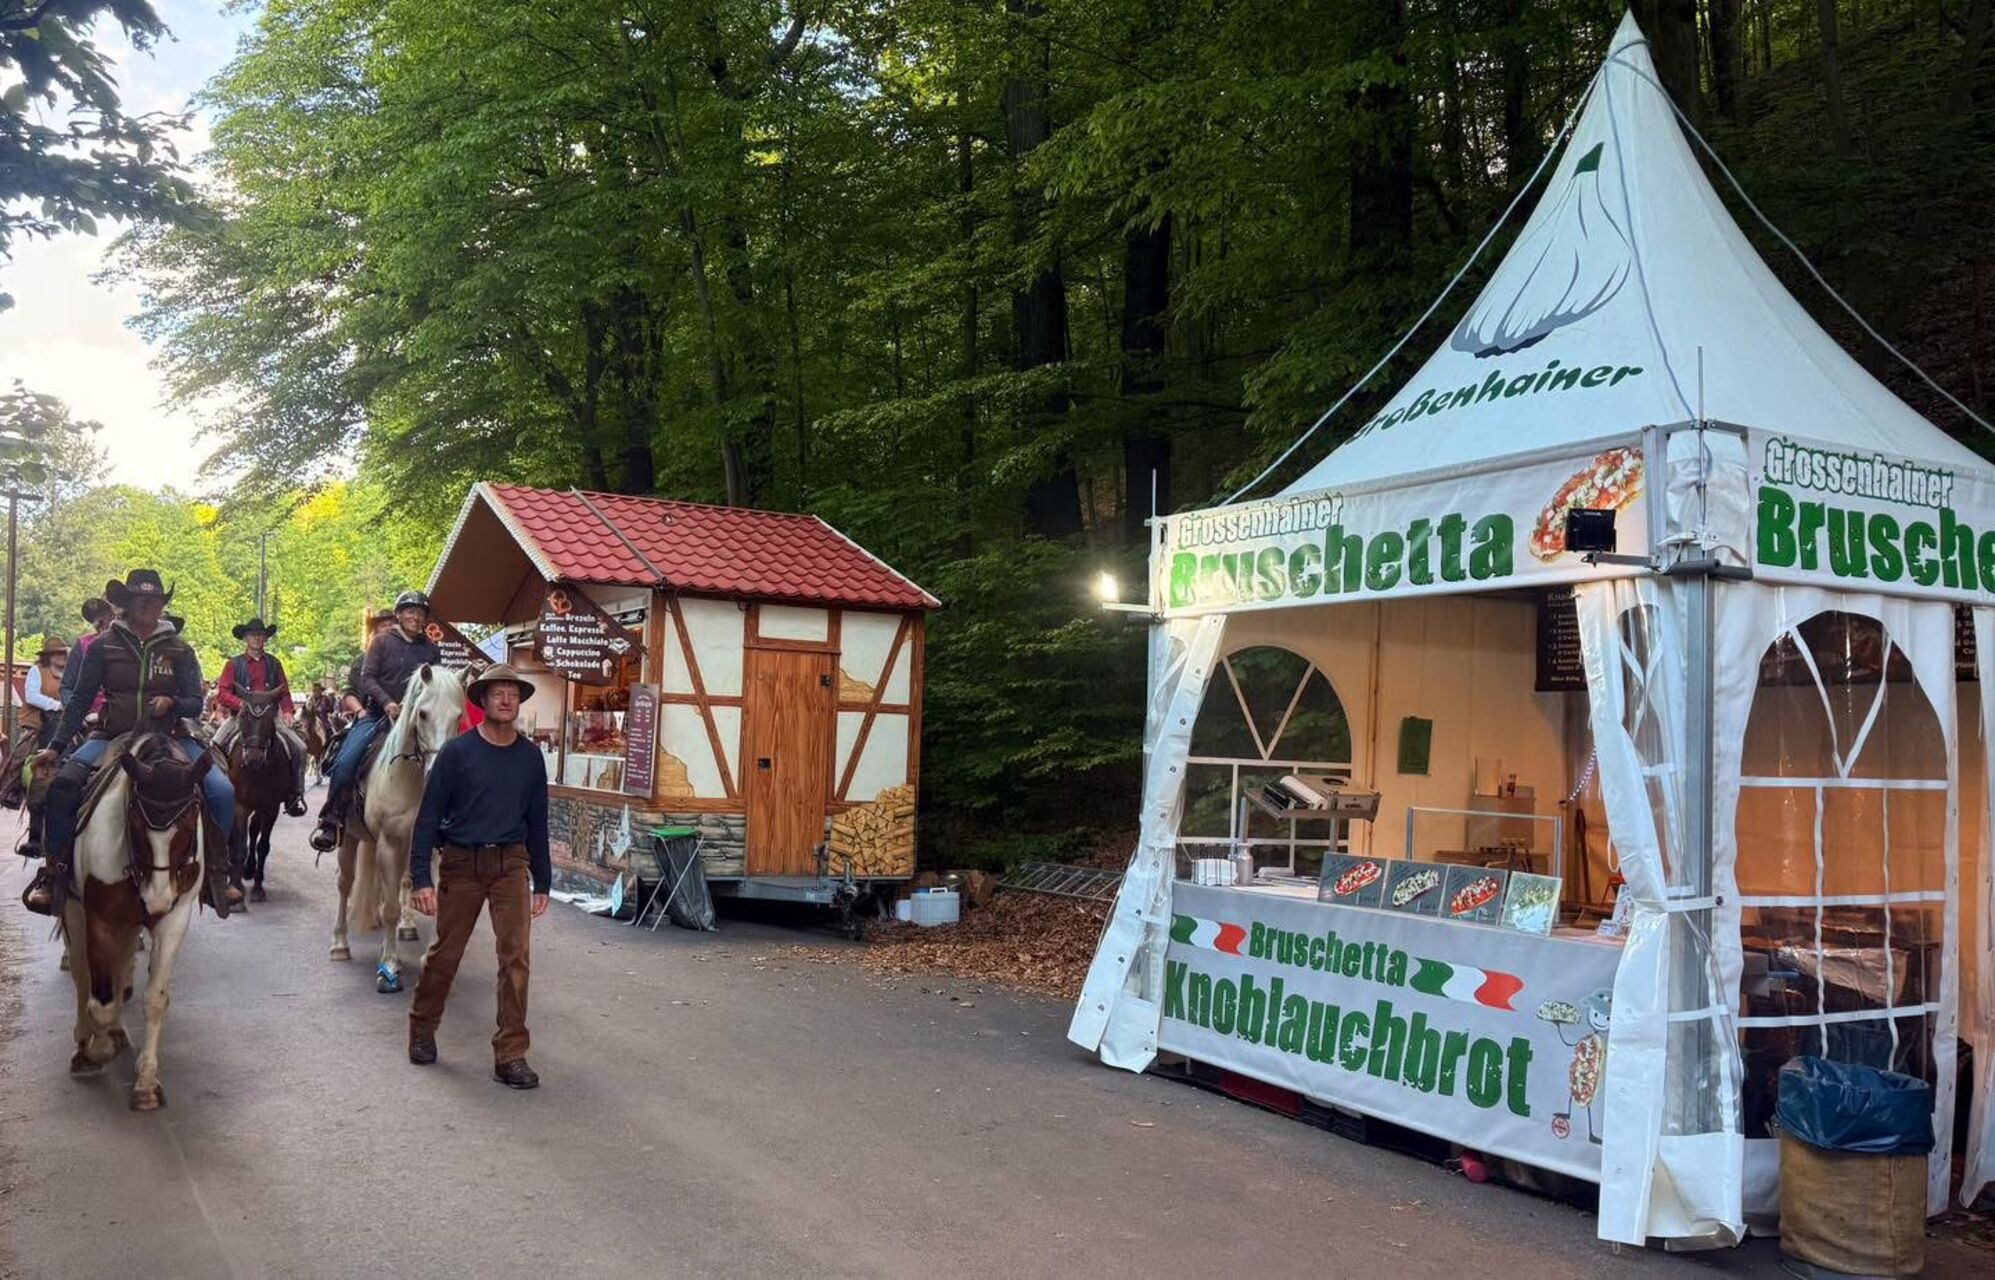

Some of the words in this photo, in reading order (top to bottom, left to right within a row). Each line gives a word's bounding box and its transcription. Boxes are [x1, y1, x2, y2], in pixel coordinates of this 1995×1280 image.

[1763, 435, 1954, 508] Grossenhainer
[1178, 492, 1344, 549] Grossenhainer
[1170, 512, 1514, 609] Bruschetta
[546, 635, 568, 644] Latte
[569, 636, 609, 646] Macchiato
[555, 659, 601, 669] Schokolade
[556, 646, 601, 657] Cappuccino
[567, 670, 582, 679] Tee
[1248, 921, 1409, 988] Bruschetta
[1164, 960, 1533, 1118] Knoblauchbrot
